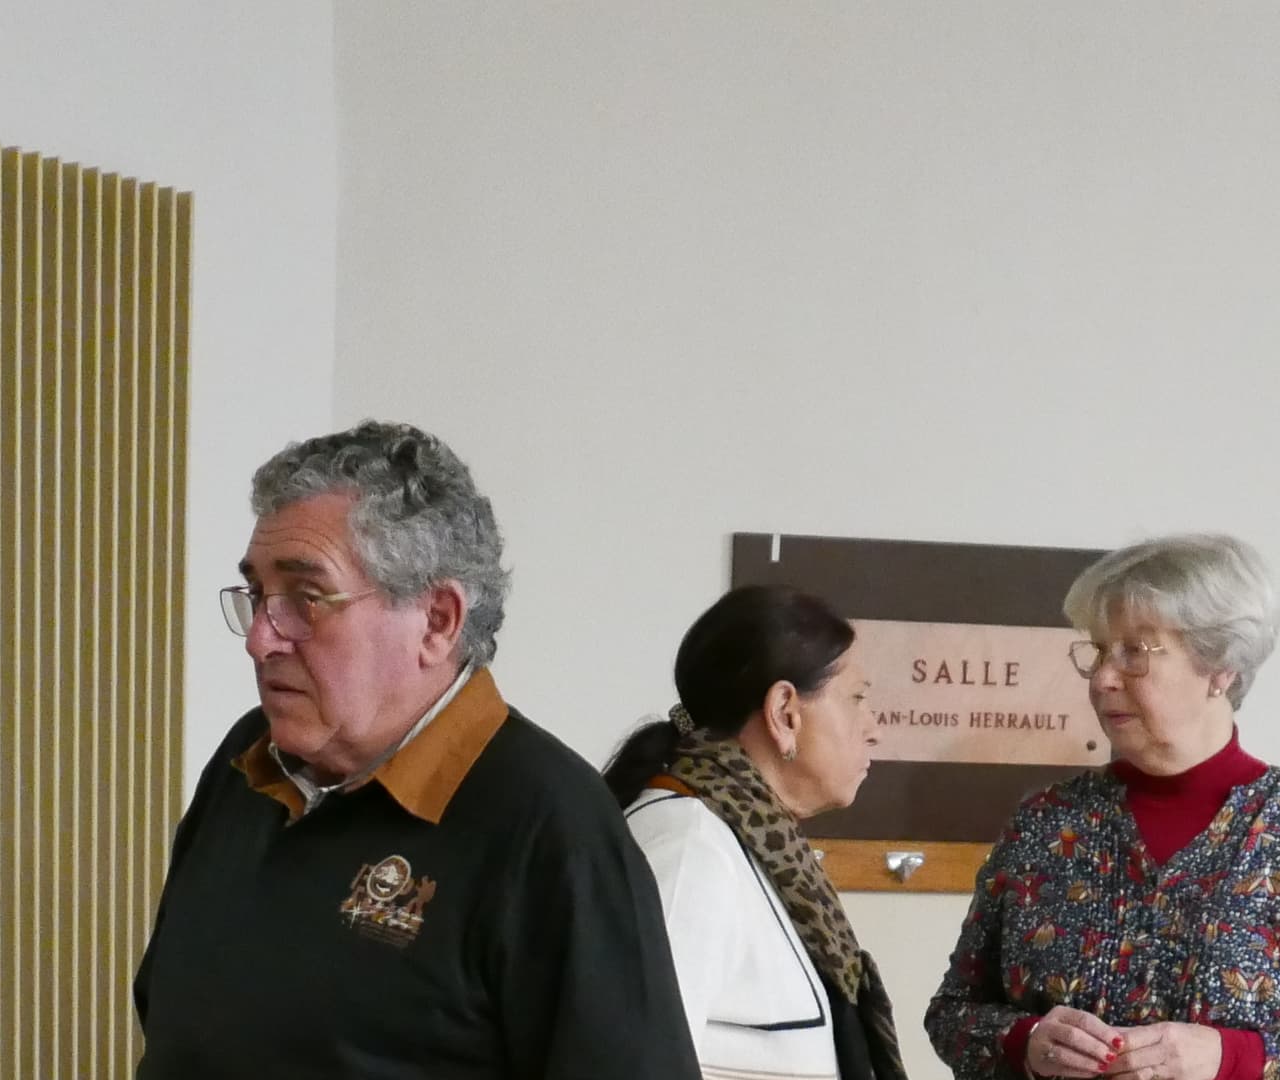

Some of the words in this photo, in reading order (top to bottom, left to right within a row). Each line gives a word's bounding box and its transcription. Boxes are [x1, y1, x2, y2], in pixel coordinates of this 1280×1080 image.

[912, 659, 1021, 686] SALLE
[872, 709, 959, 727] AN-LOUIS
[969, 711, 1070, 731] HERRAULT
